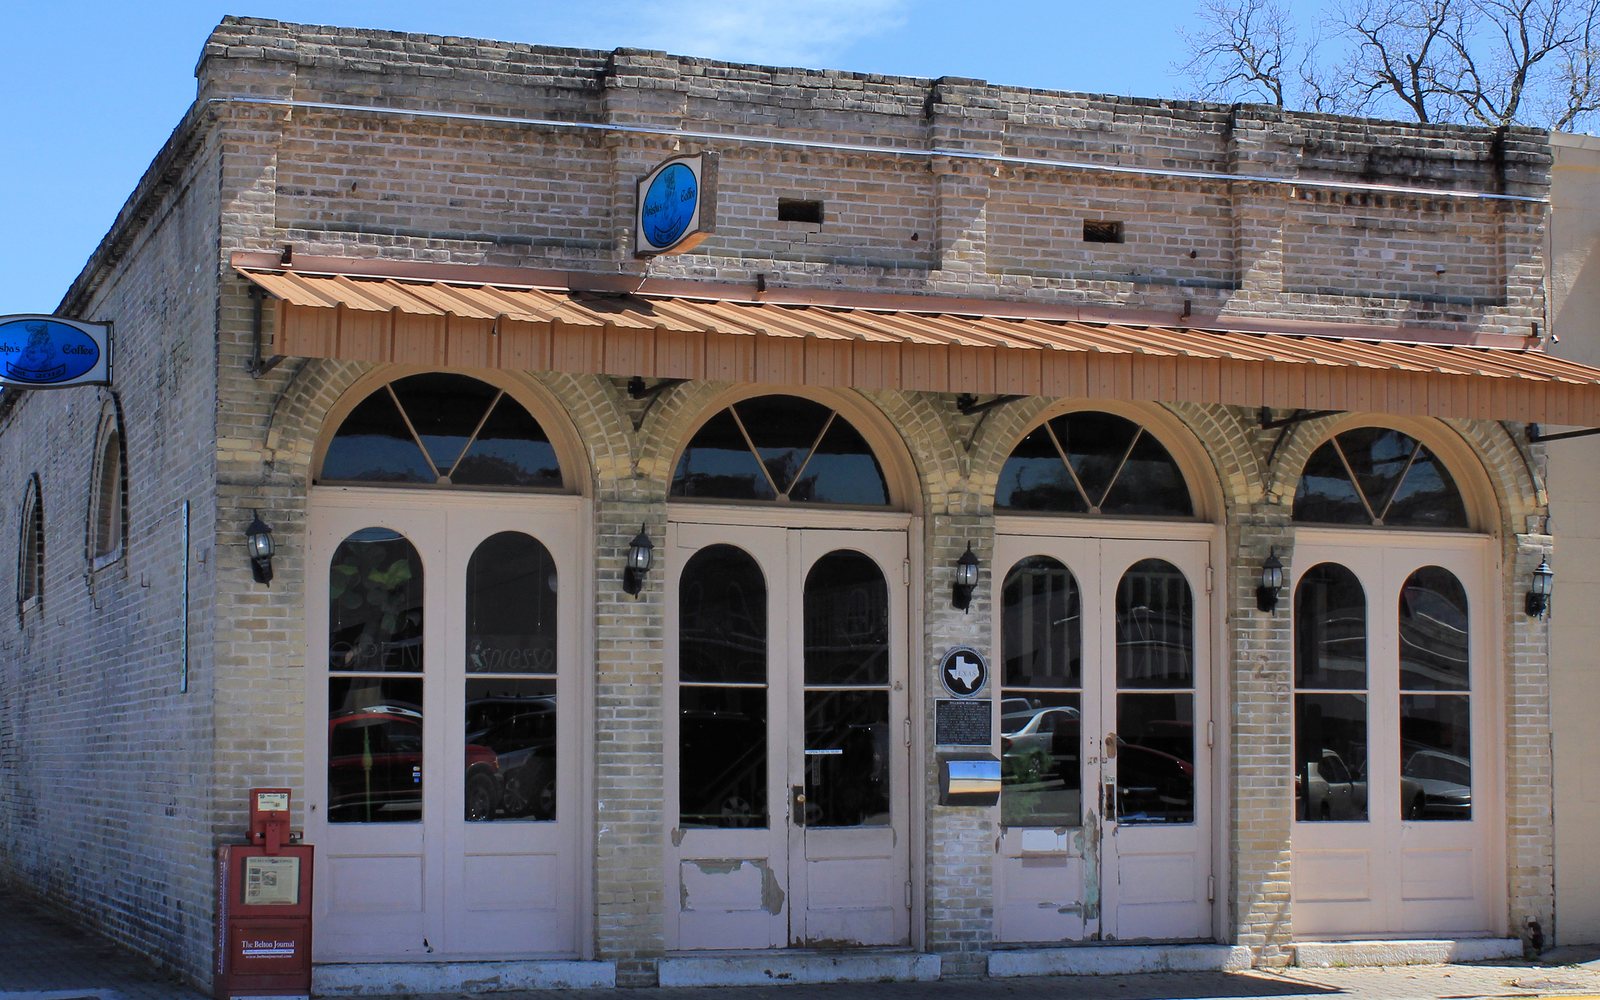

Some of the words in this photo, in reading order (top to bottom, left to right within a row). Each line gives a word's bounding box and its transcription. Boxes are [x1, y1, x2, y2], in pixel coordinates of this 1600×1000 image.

[63, 343, 94, 355] Coffee
[468, 646, 553, 673] spresso
[274, 941, 295, 949] Journal
